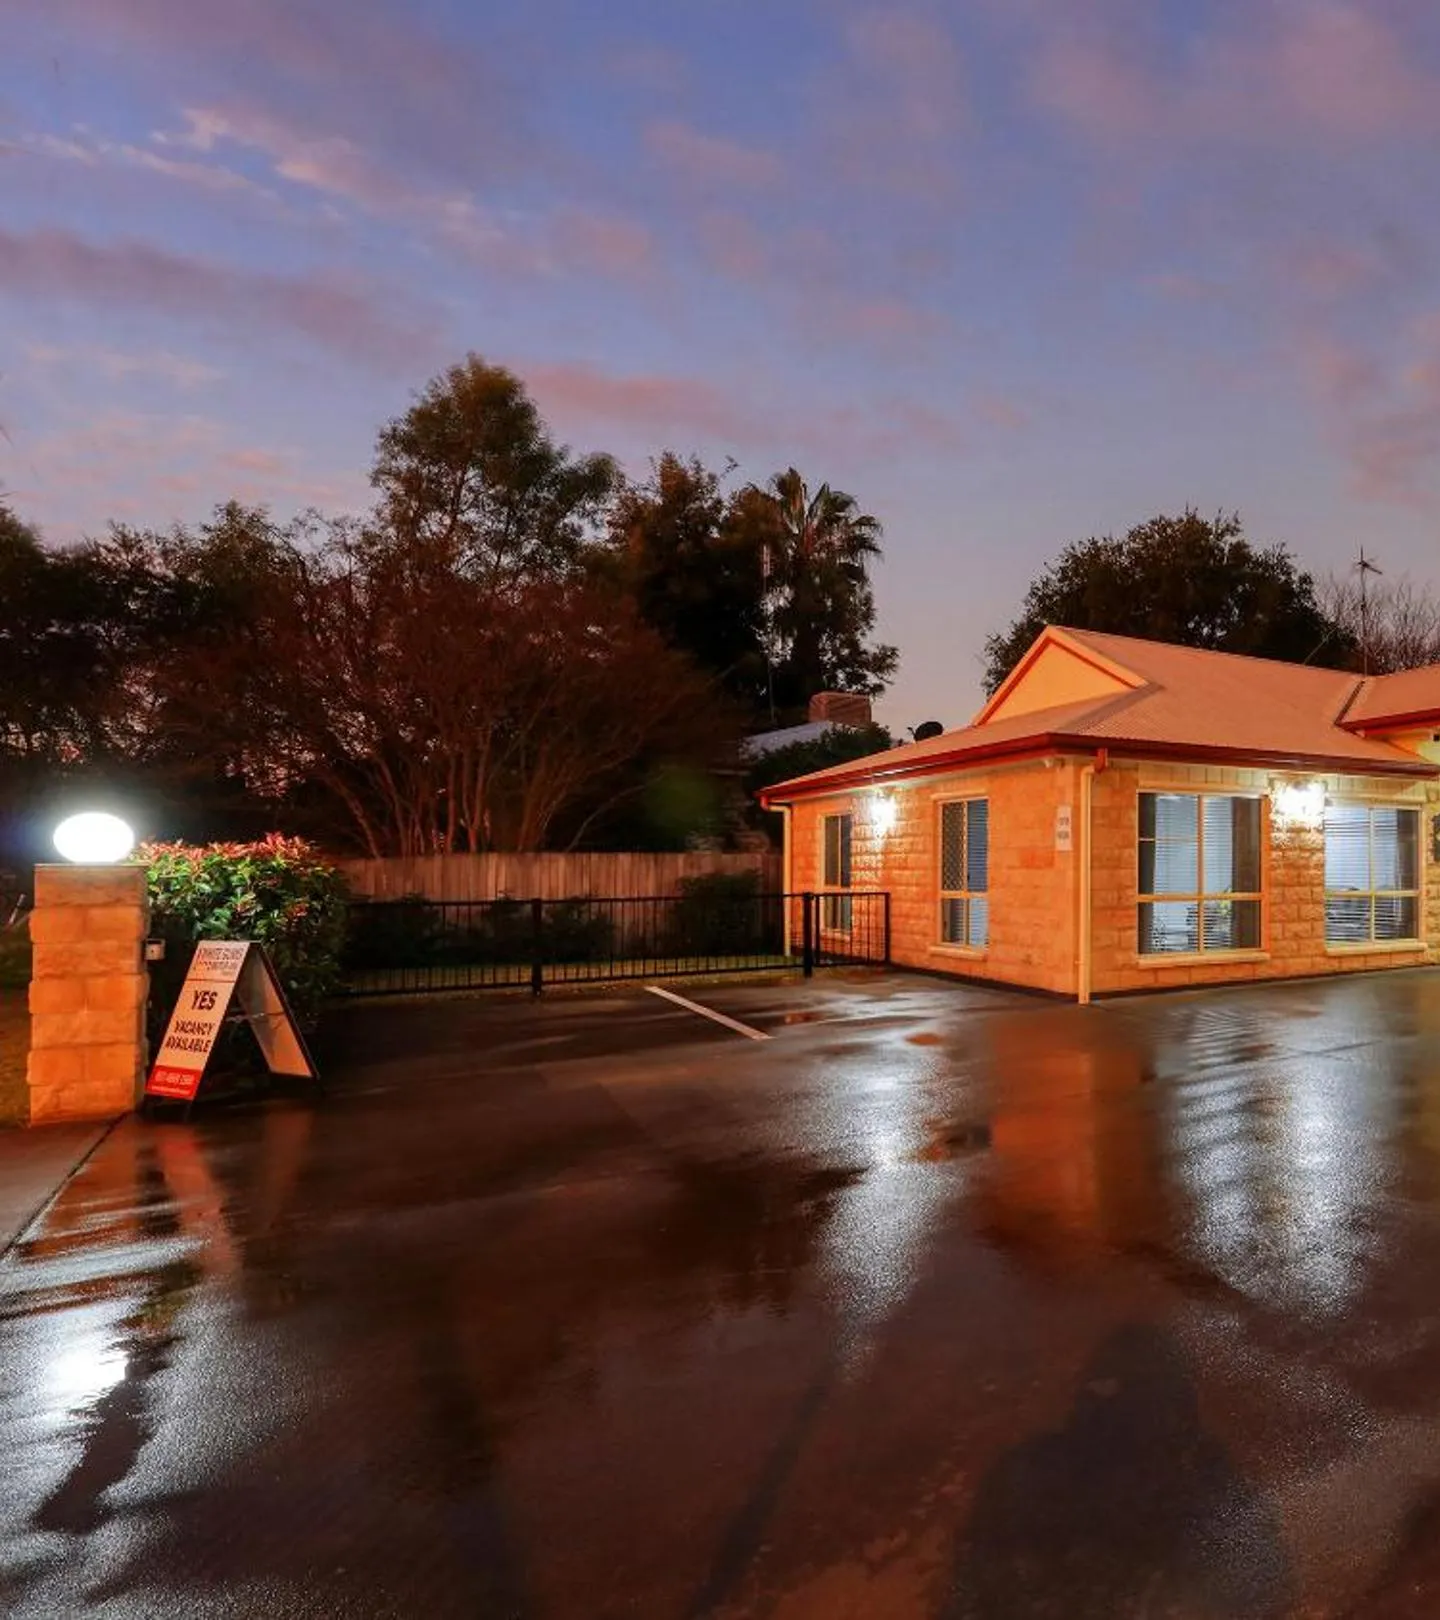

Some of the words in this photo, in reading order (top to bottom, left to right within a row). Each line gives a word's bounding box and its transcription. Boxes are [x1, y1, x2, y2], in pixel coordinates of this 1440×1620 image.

[191, 990, 218, 1010] YES
[174, 1020, 215, 1035] VACANCY
[165, 1036, 211, 1053] AVAILABLE
